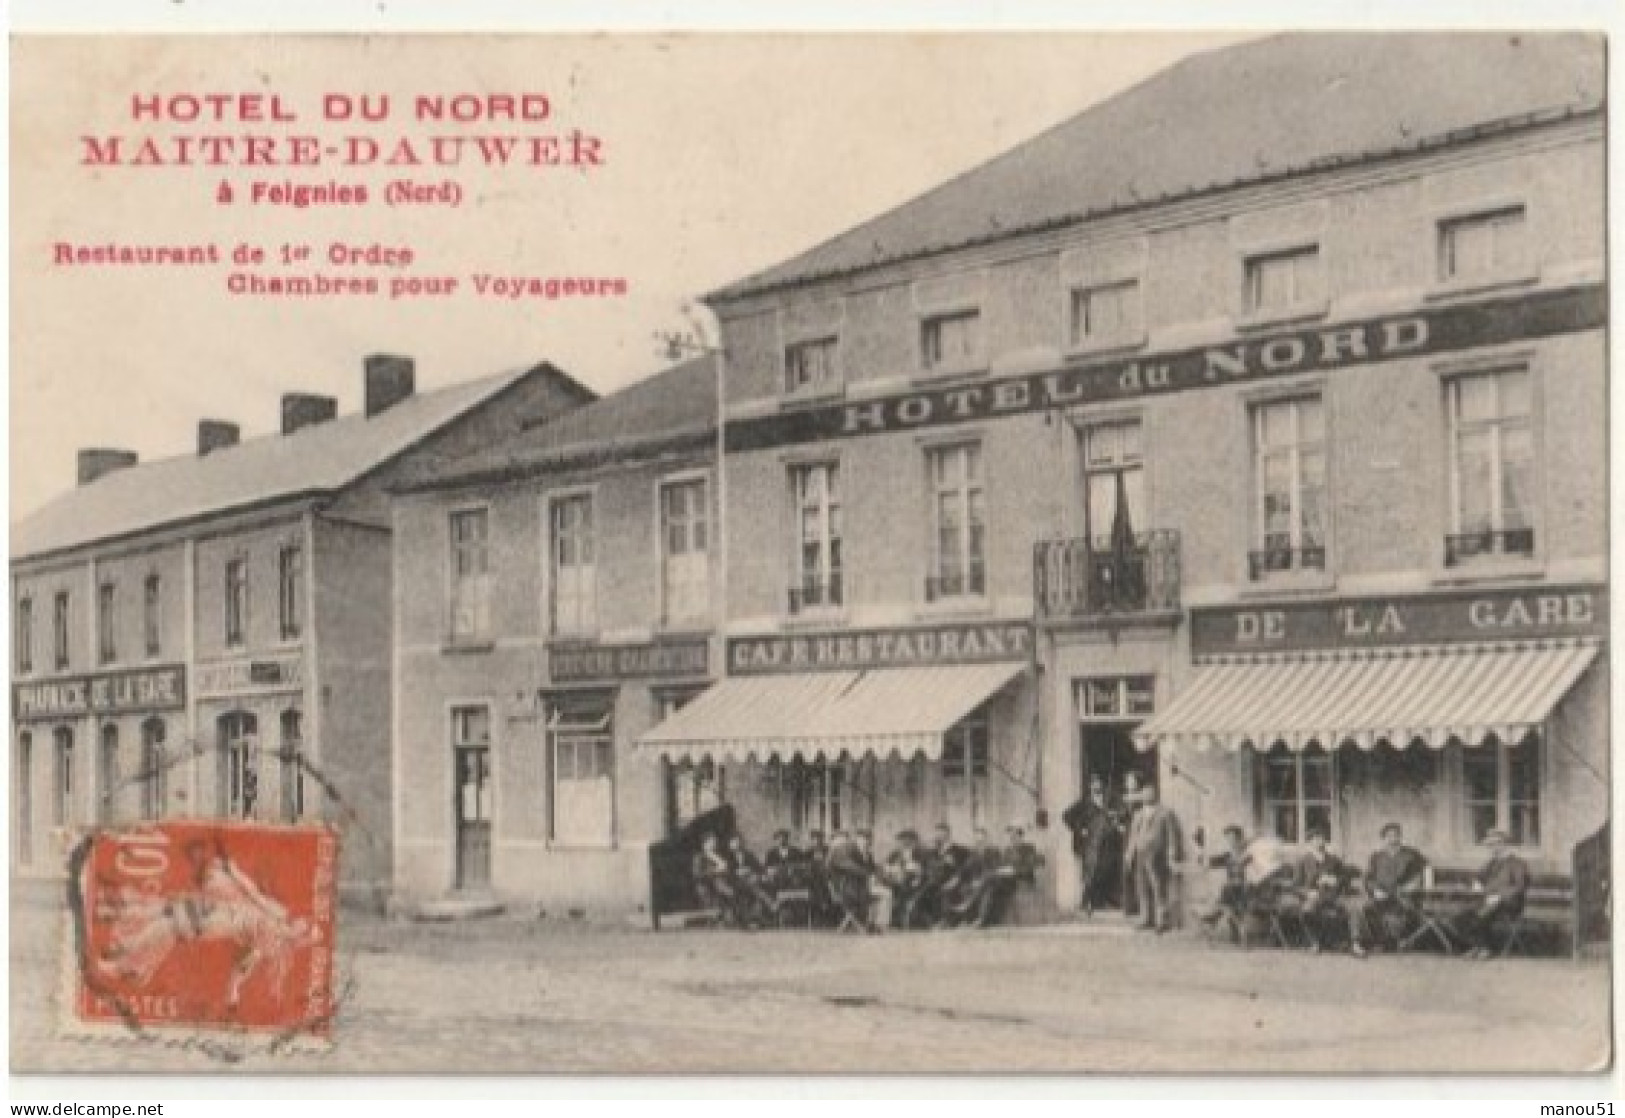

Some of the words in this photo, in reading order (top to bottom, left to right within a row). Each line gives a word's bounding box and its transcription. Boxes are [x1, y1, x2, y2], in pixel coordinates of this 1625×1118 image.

[130, 93, 296, 122] HOTEL
[323, 93, 392, 122] DU
[414, 93, 552, 122] NORD
[80, 131, 606, 169] MAITRE-DAUWER
[215, 180, 237, 206] à
[51, 241, 223, 267] Restaurant
[233, 243, 266, 266] de
[329, 242, 416, 268] Ordre
[226, 273, 379, 298] Chambres
[389, 275, 458, 300] pour
[473, 273, 629, 301] Voyageurs
[842, 373, 1083, 432] HOTEL
[1119, 361, 1171, 392] du
[1203, 317, 1429, 380] NORD
[1235, 609, 1286, 643] DE
[1343, 604, 1407, 637] LA
[1468, 592, 1595, 628] GARE
[815, 624, 1030, 664] RESTAURANT
